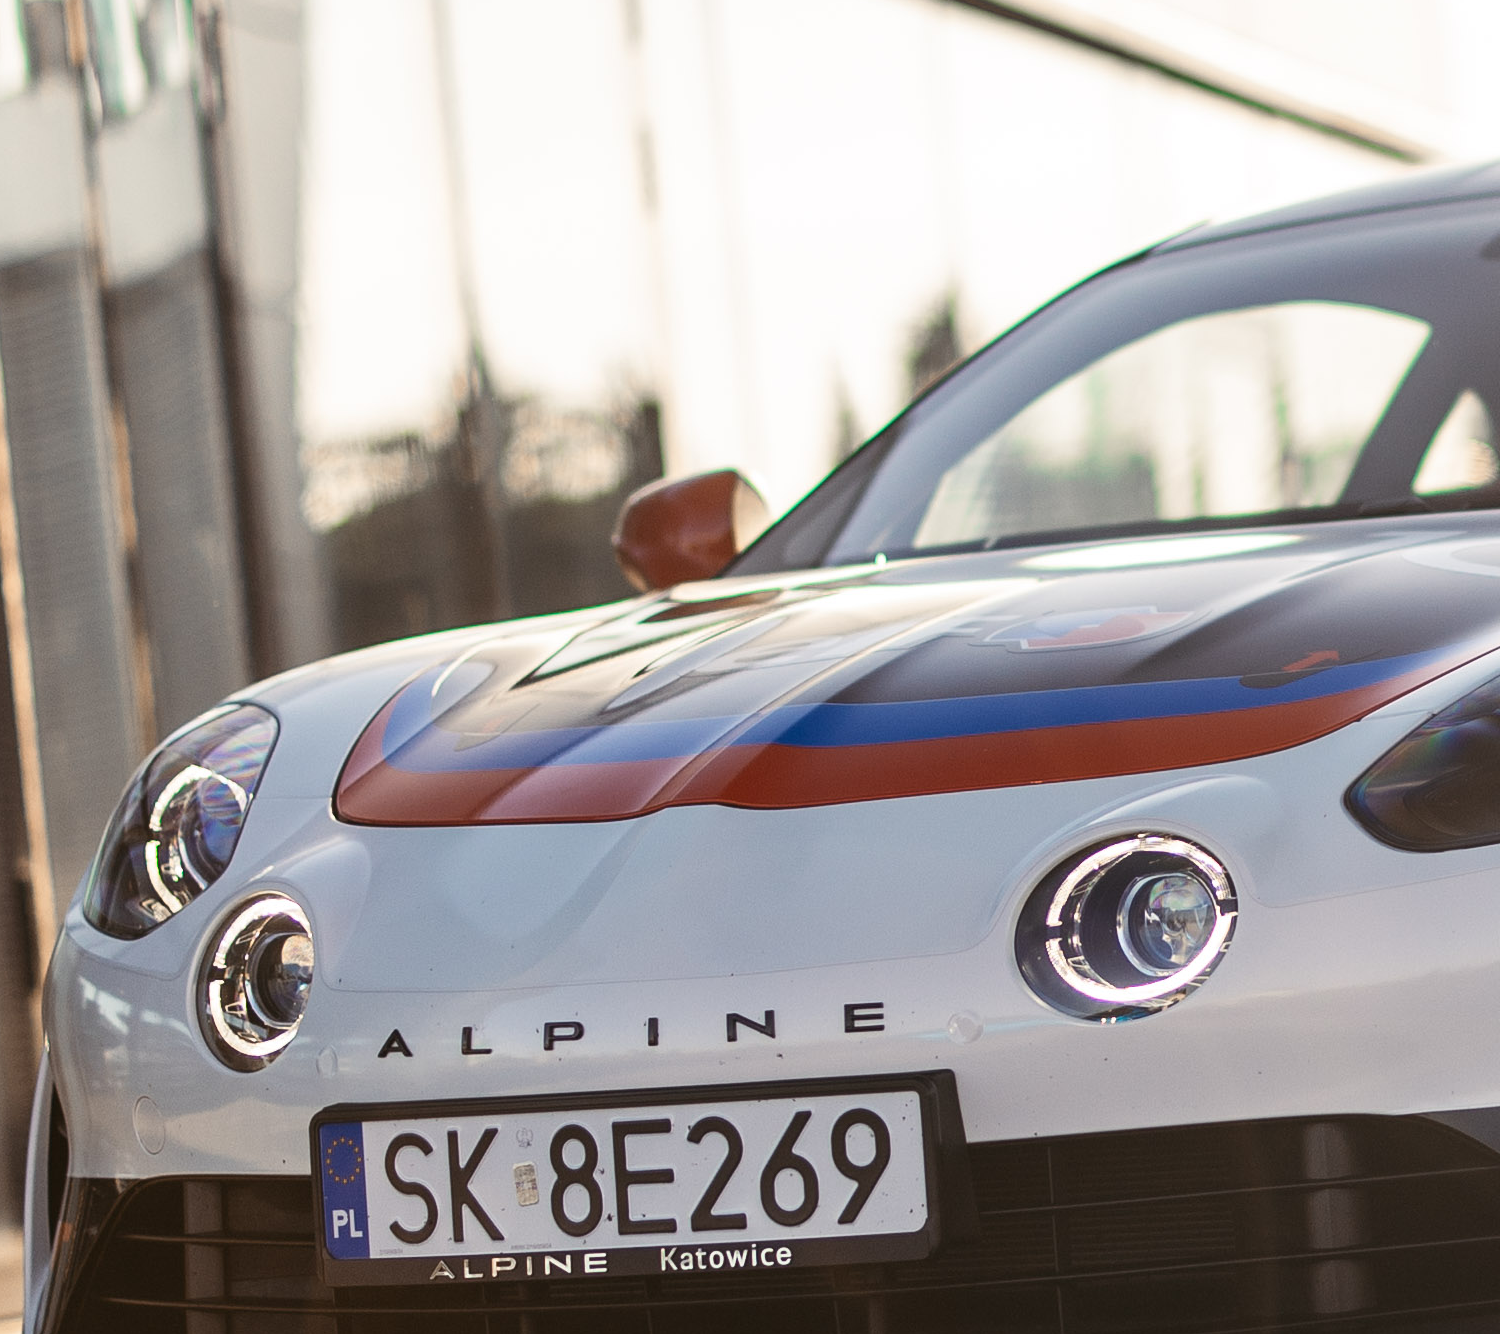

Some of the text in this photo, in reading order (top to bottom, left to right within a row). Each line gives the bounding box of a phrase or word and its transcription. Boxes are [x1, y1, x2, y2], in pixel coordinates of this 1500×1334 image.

[378, 1003, 885, 1058] ALPINE
[384, 1108, 891, 1244] SK 8E269
[333, 1209, 364, 1239] PL
[429, 1244, 793, 1280] ALPINE Katowice
